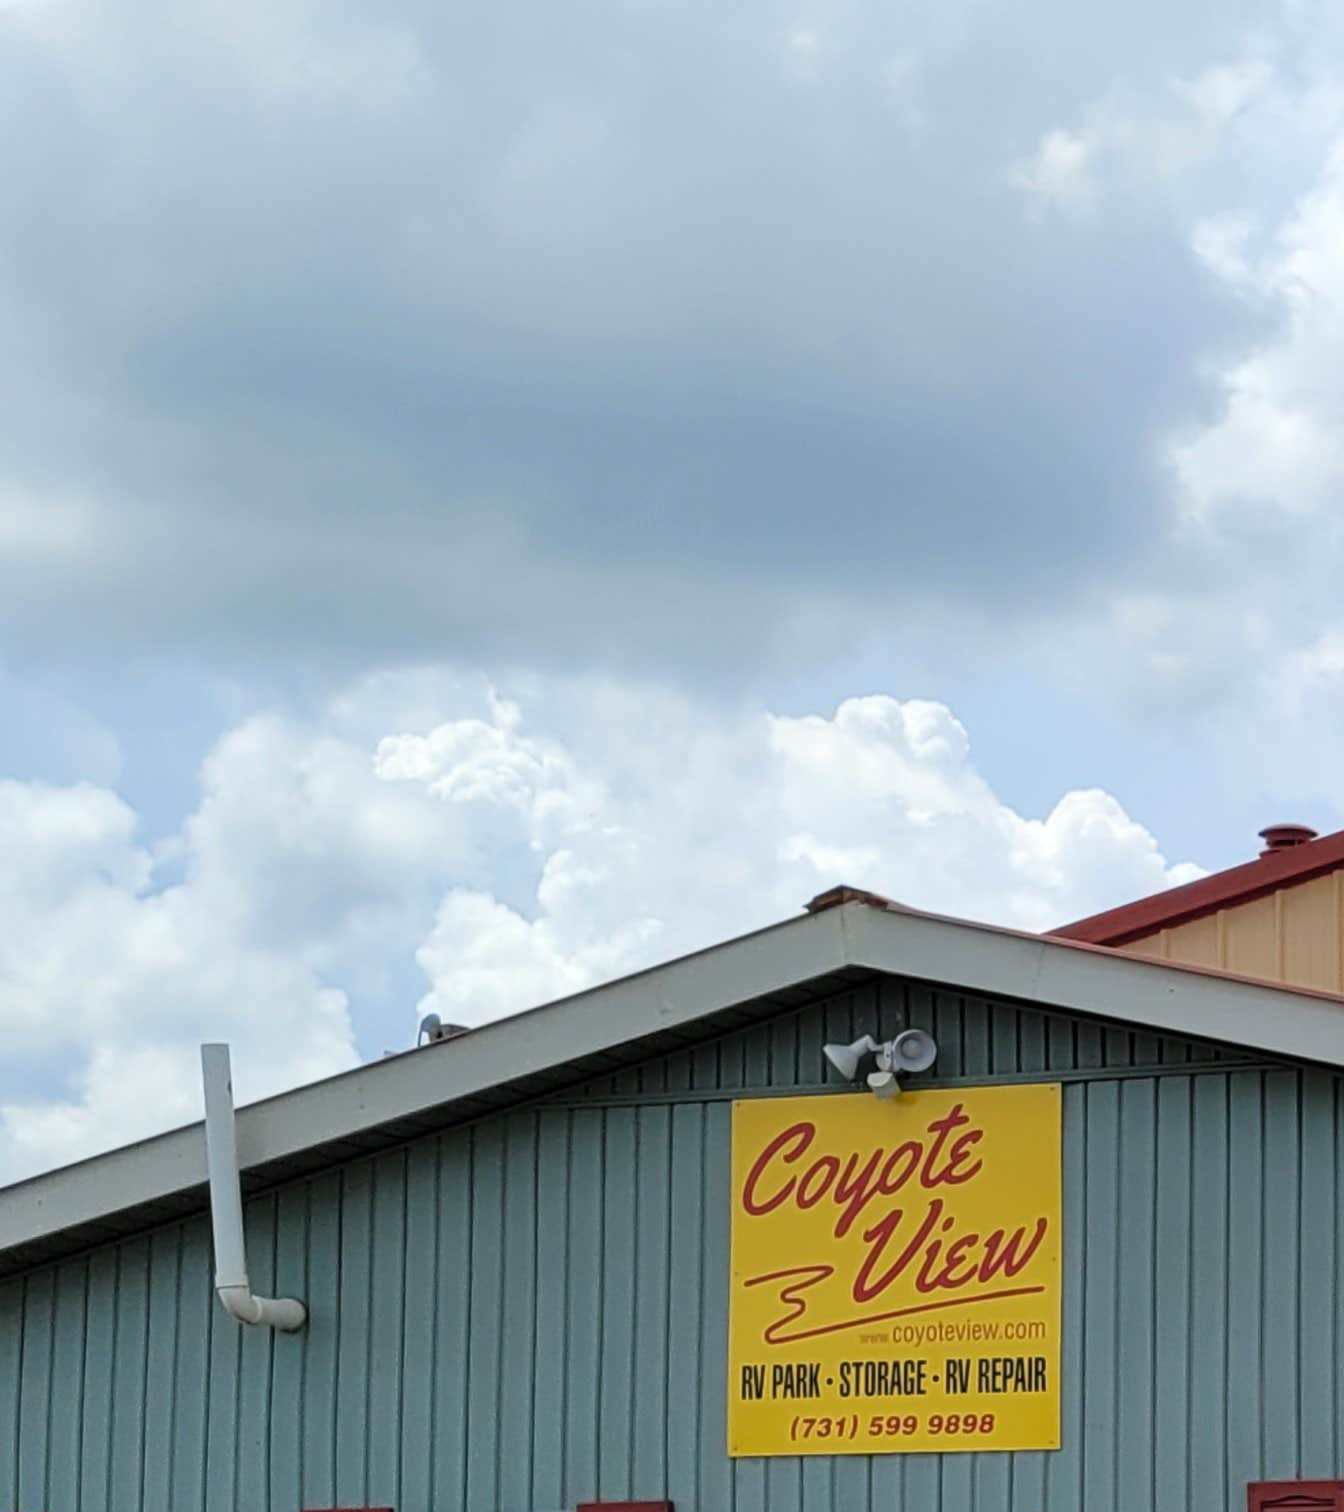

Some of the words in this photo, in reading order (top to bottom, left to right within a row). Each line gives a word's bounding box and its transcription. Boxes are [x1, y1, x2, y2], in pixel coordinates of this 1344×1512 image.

[742, 1103, 984, 1238] Coyote
[852, 1198, 1048, 1302] View
[741, 1364, 765, 1401] RV
[772, 1362, 821, 1399] PARK
[839, 1359, 927, 1398] STORAGE
[945, 1358, 971, 1395] RV
[978, 1356, 1047, 1394] REPAIR
[790, 1414, 858, 1441] (731)
[868, 1415, 918, 1437] 599
[927, 1413, 995, 1436] 9898
